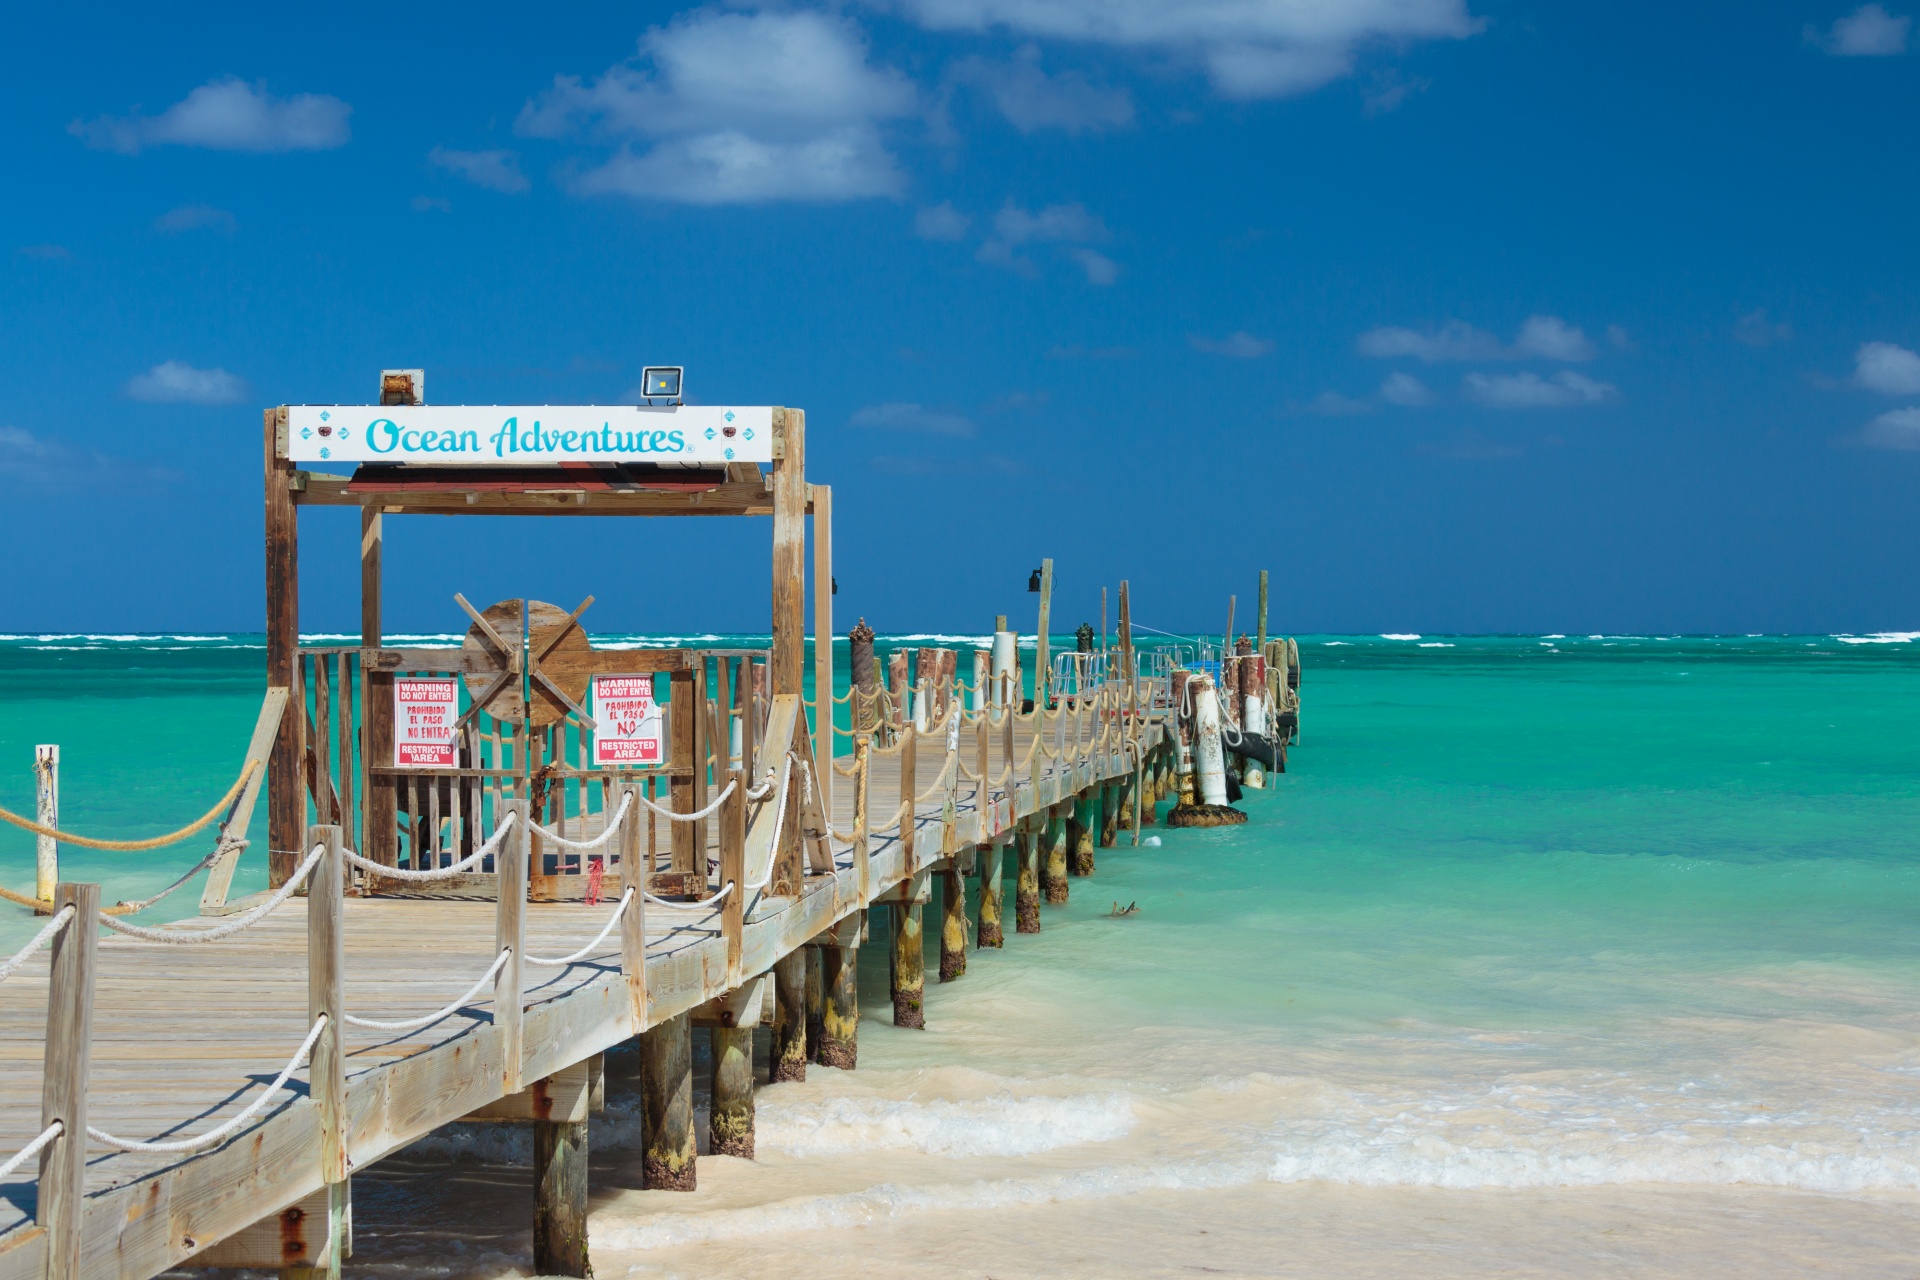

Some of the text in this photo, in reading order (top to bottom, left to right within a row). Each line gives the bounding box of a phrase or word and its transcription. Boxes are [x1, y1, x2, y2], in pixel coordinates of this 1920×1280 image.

[365, 418, 483, 453] Ocean
[401, 683, 450, 692] WARNING
[401, 692, 451, 700] DO NOT ENTER
[600, 688, 651, 696] DO NOT ENTE
[407, 706, 445, 714] PROHIBIDO
[410, 716, 442, 724] EL PASO
[610, 712, 617, 720] EL
[617, 721, 636, 735] NO
[408, 727, 450, 739] NO ENTRA
[402, 745, 451, 754] RESTRICTED
[602, 742, 655, 750] RESTRICTED
[414, 754, 439, 762] AREA
[614, 750, 642, 758] AREA
